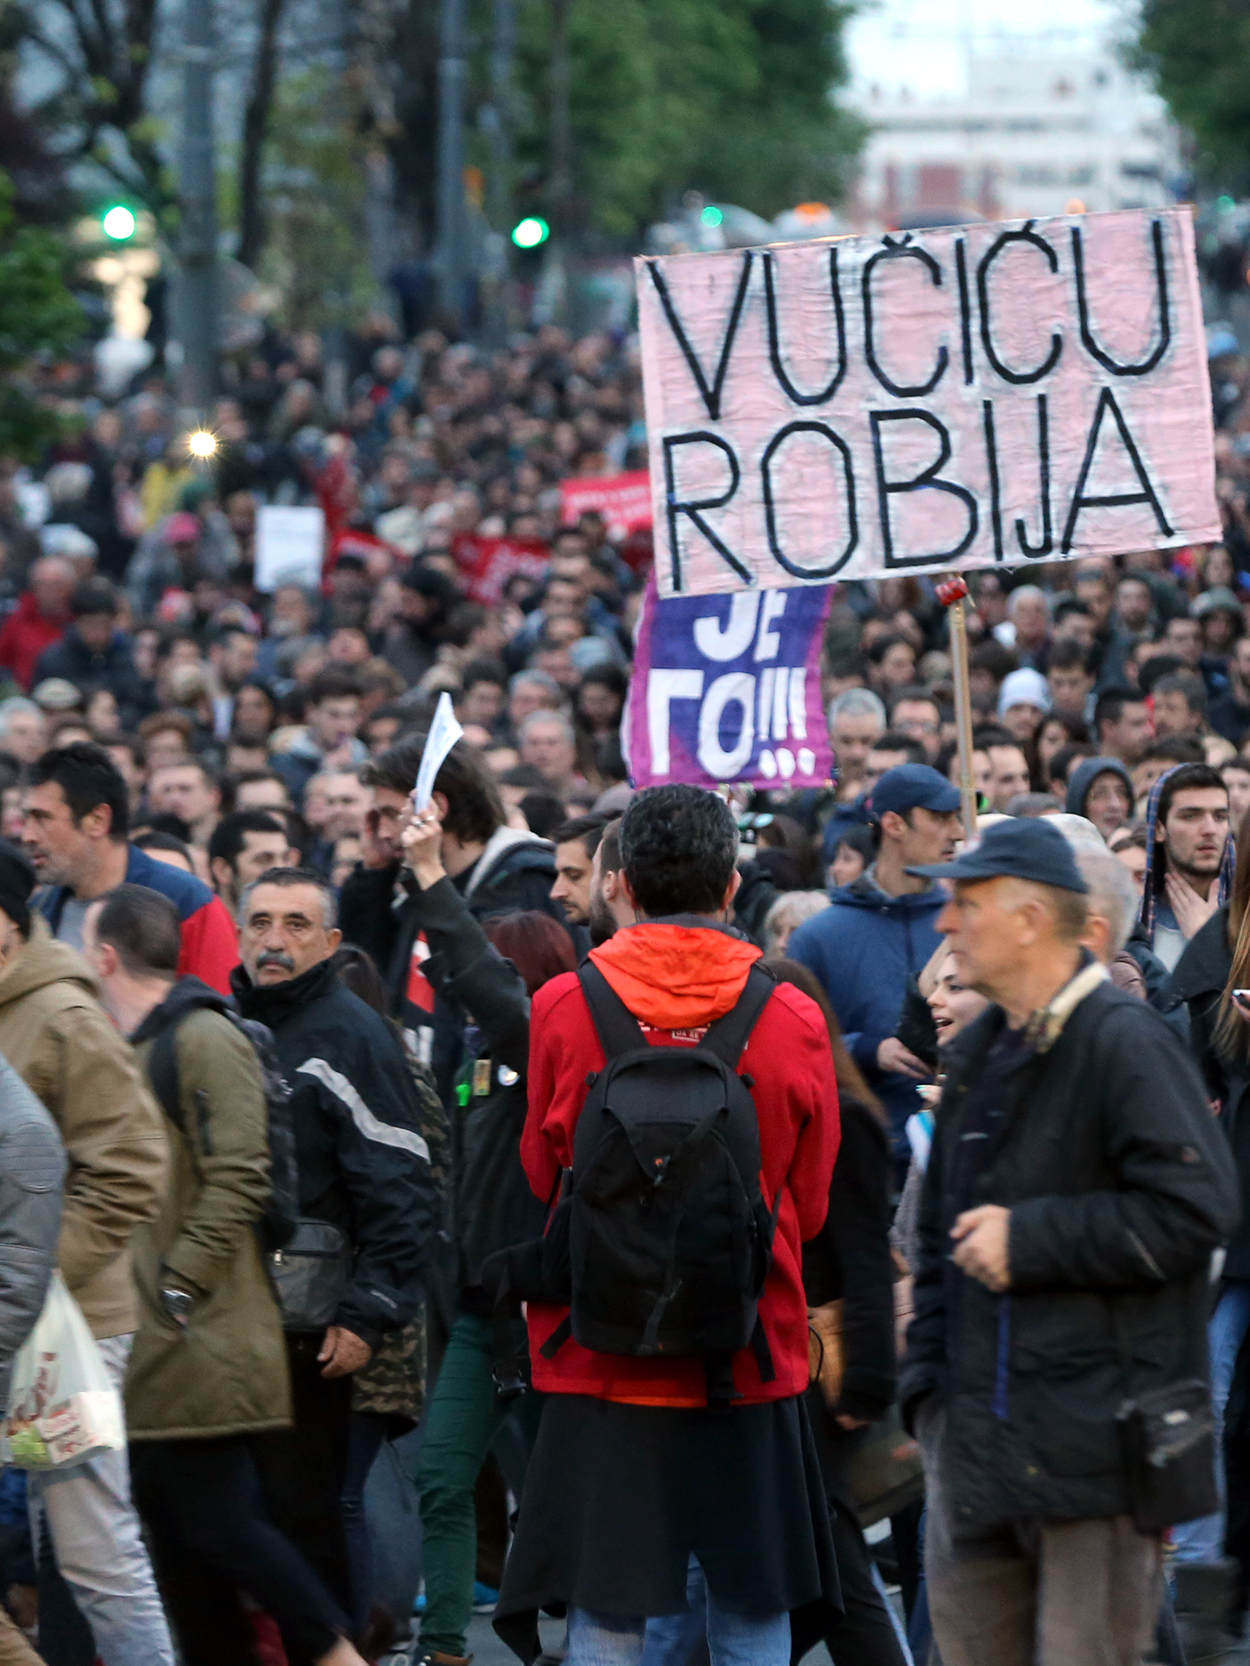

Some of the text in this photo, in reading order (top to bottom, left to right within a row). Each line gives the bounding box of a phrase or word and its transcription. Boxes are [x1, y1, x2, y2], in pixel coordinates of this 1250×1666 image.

[647, 220, 1170, 420] VUČIĆU
[663, 387, 1175, 592] ROBIJA
[647, 666, 816, 780] ГО!!!
